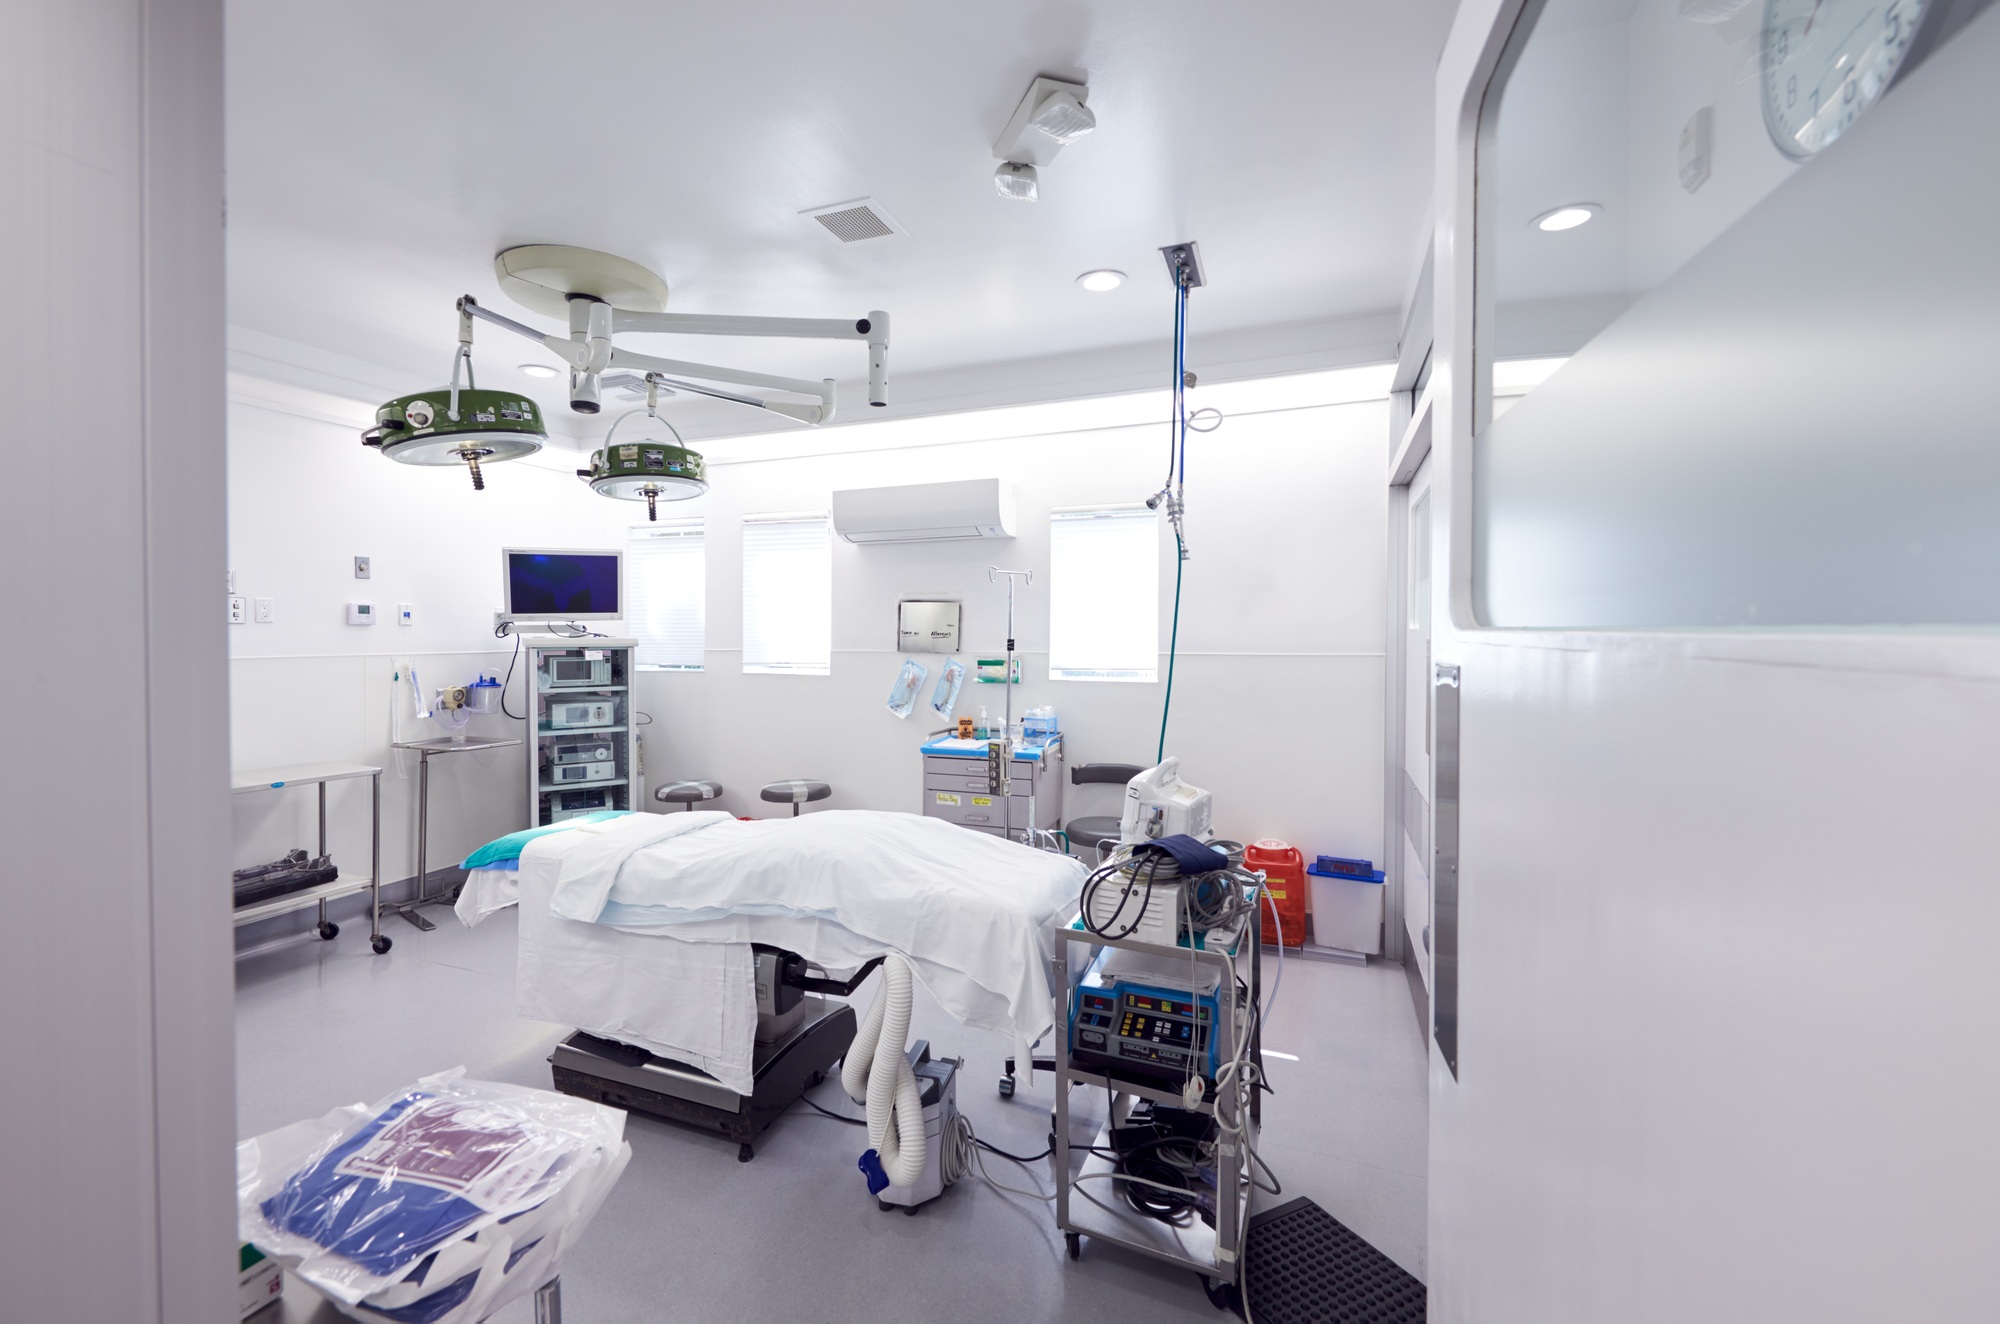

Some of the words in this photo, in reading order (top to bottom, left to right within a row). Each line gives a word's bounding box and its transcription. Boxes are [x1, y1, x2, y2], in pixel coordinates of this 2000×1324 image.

[1885, 0, 1901, 46] 5
[1777, 29, 1788, 65] 9
[1787, 74, 1797, 109] 8
[1808, 87, 1821, 117] 7
